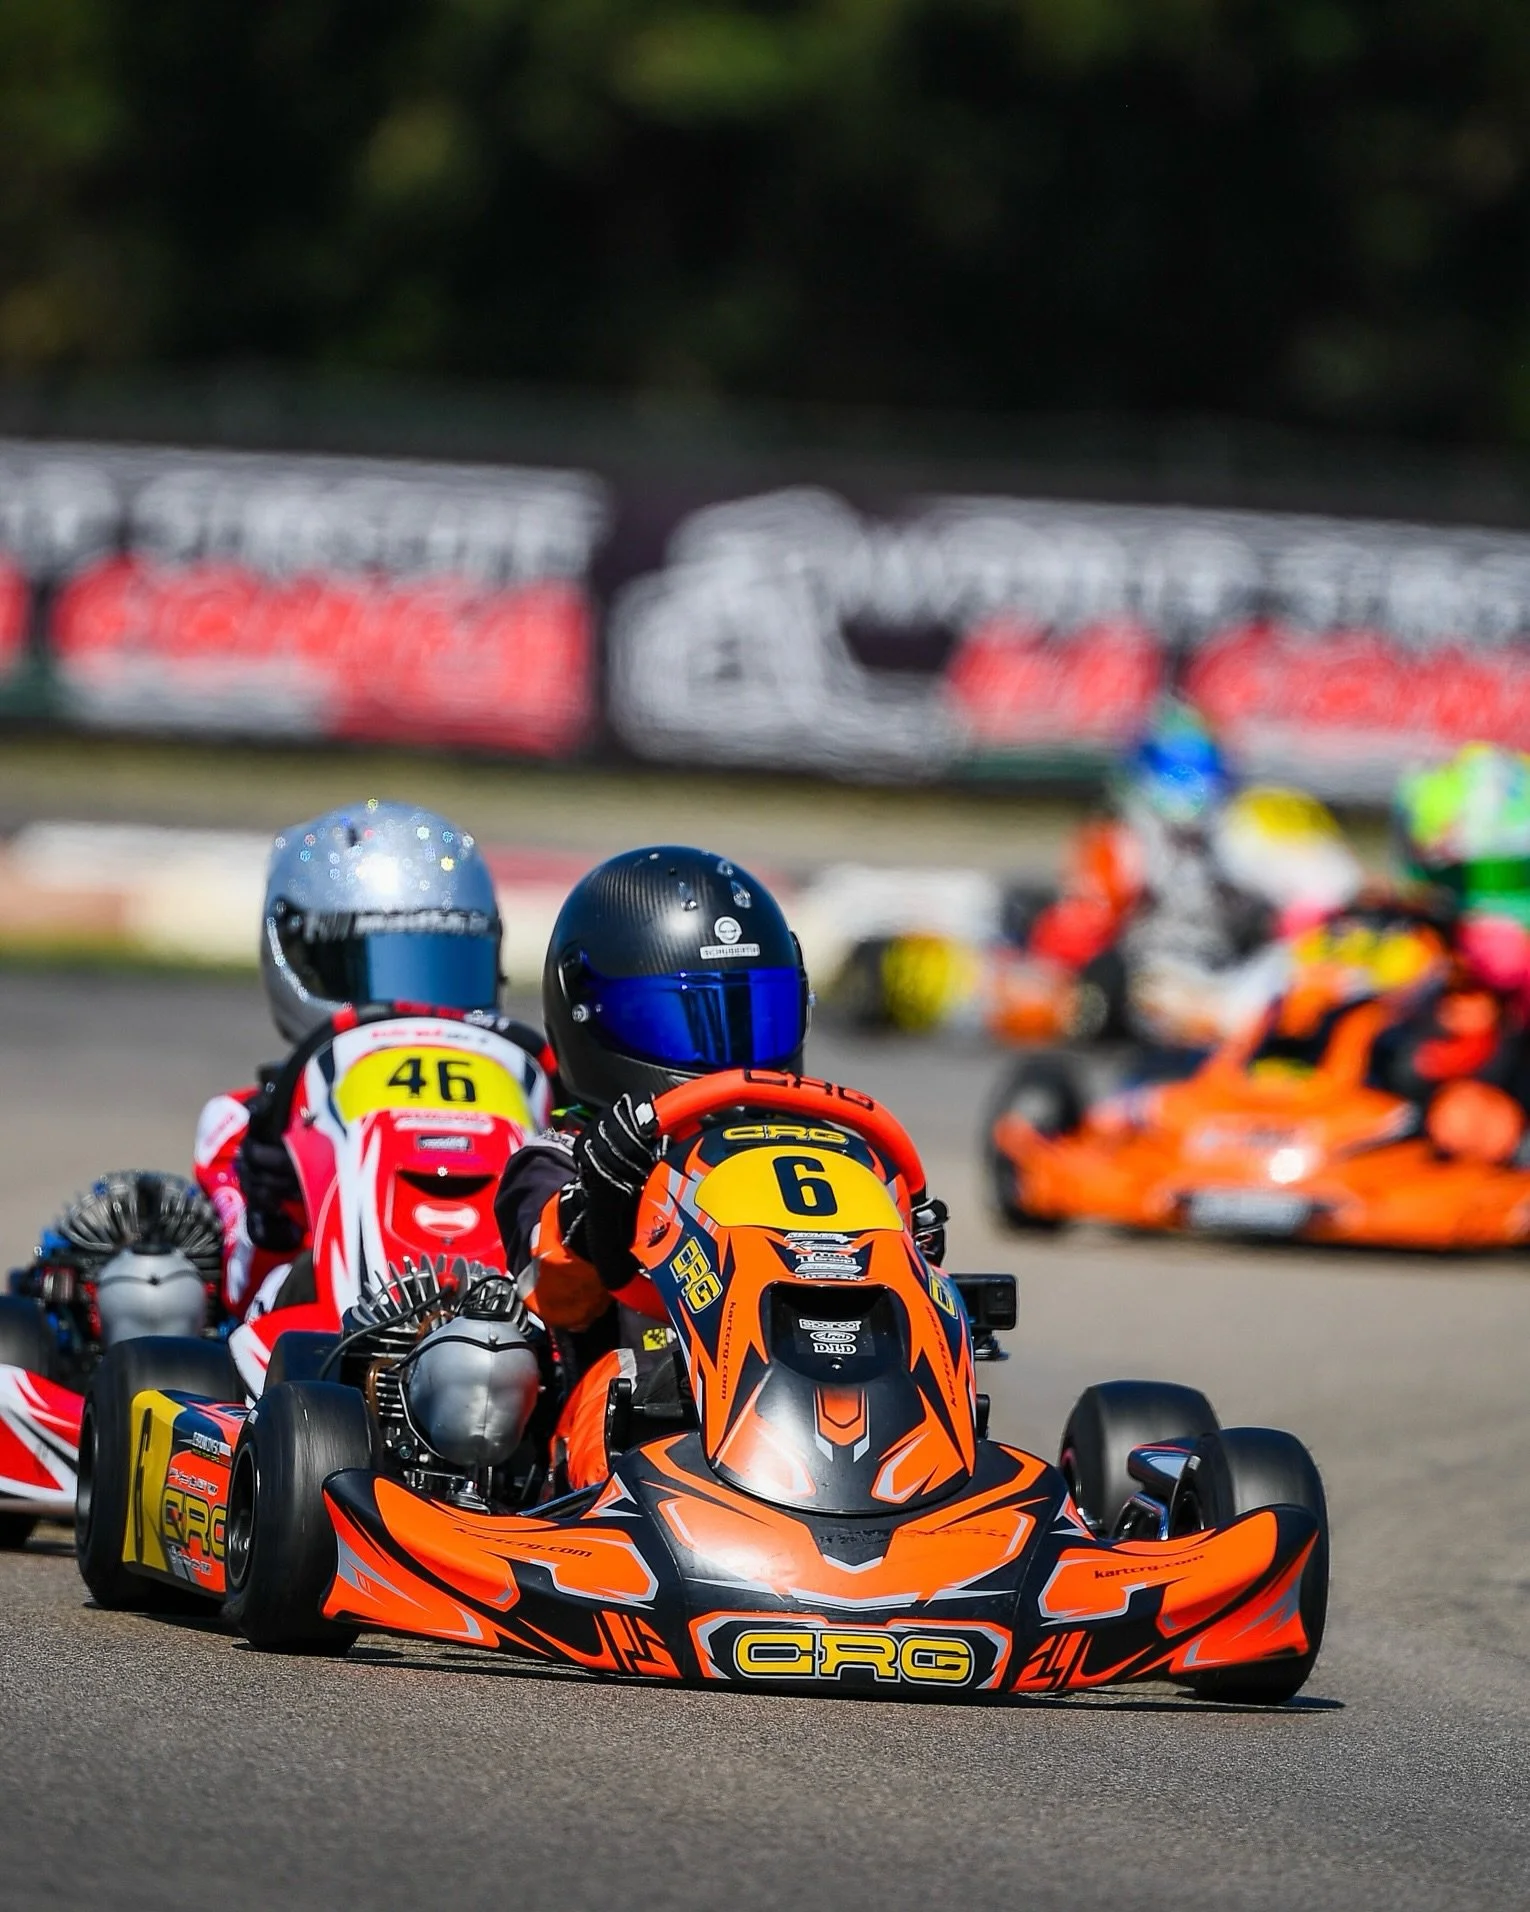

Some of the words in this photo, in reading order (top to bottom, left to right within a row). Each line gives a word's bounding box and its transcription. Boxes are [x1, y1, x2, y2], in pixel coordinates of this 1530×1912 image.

[387, 1056, 477, 1103] 46
[722, 1124, 849, 1145] CRG
[772, 1155, 838, 1216] 6
[669, 1236, 724, 1315] CRG
[721, 1301, 737, 1400] kartcrg.com
[733, 1629, 976, 1687] CRG
